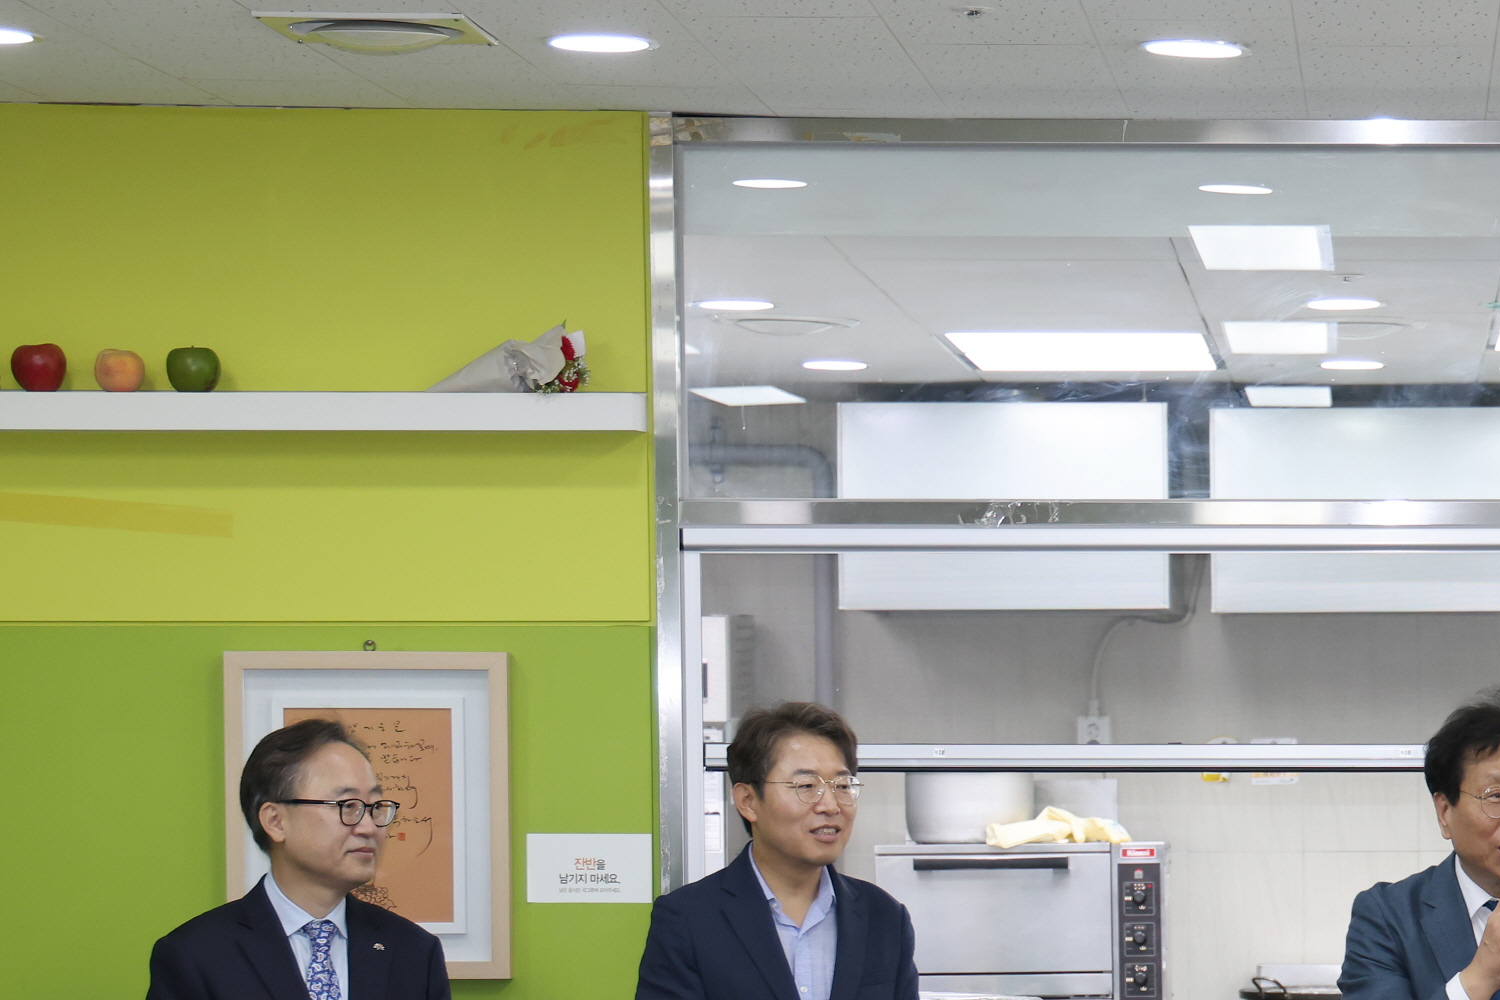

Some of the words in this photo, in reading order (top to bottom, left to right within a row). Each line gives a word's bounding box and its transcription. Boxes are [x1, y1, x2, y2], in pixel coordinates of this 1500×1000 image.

[574, 857, 606, 871] 잔반을
[558, 873, 588, 885] 남기지
[590, 873, 621, 885] 마세요.
